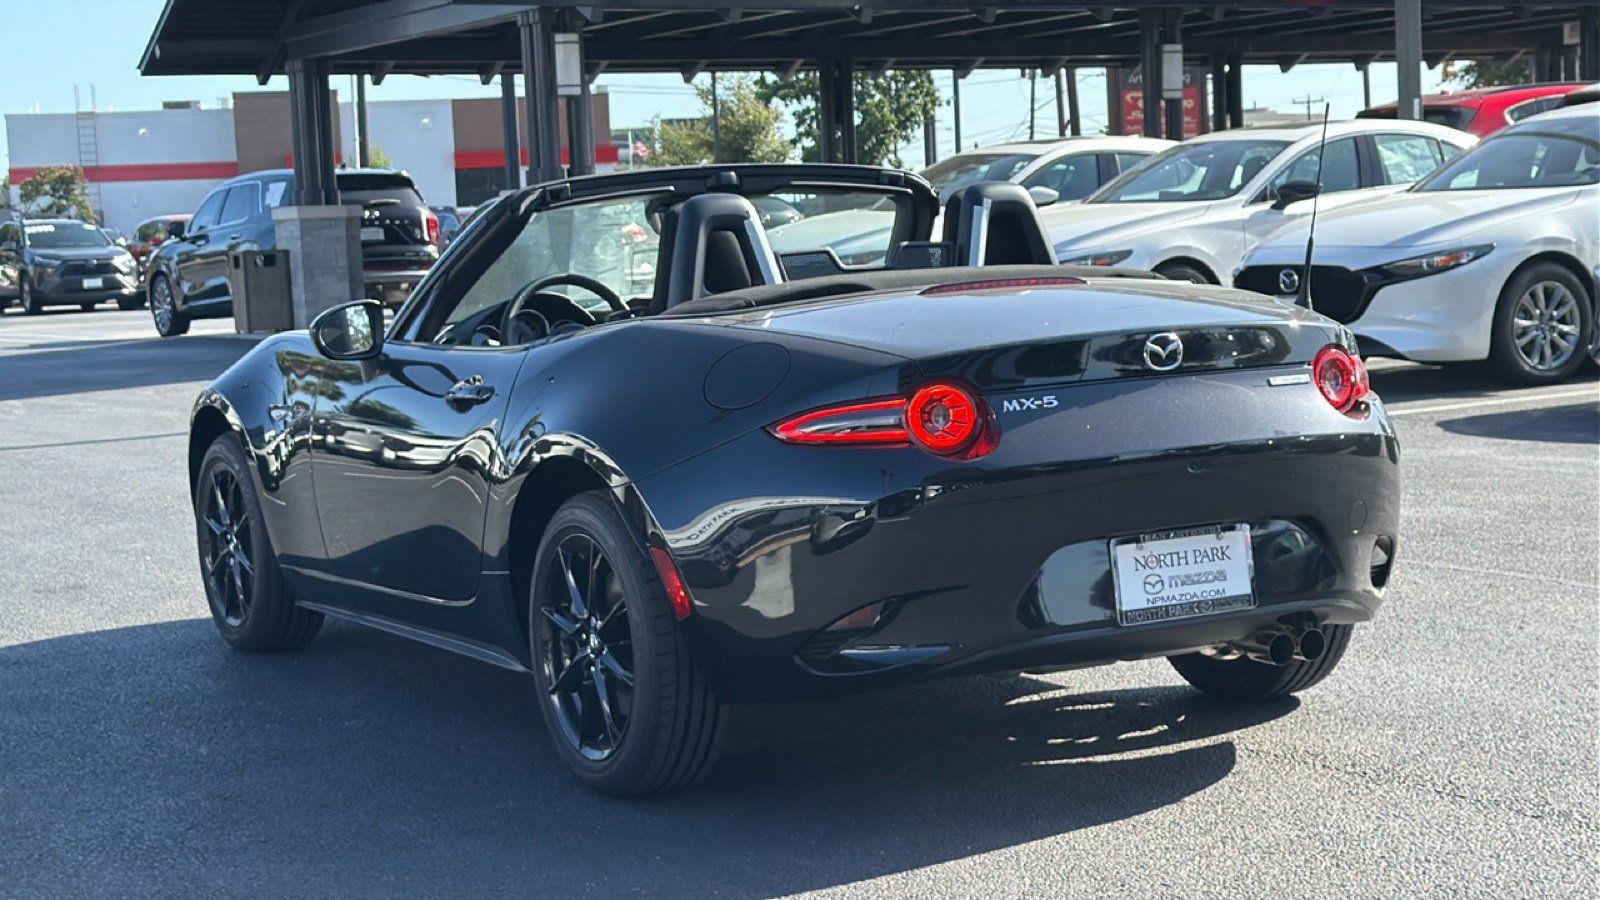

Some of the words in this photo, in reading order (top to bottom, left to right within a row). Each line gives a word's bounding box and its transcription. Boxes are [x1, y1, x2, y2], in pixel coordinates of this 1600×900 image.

[1003, 395, 1059, 413] MX-5
[1133, 551, 1189, 572] NORTH
[1193, 545, 1232, 565] PARK
[1168, 570, 1227, 589] mazda
[1146, 588, 1226, 605] NPMAZDA.COM
[1126, 607, 1166, 624] NORTH
